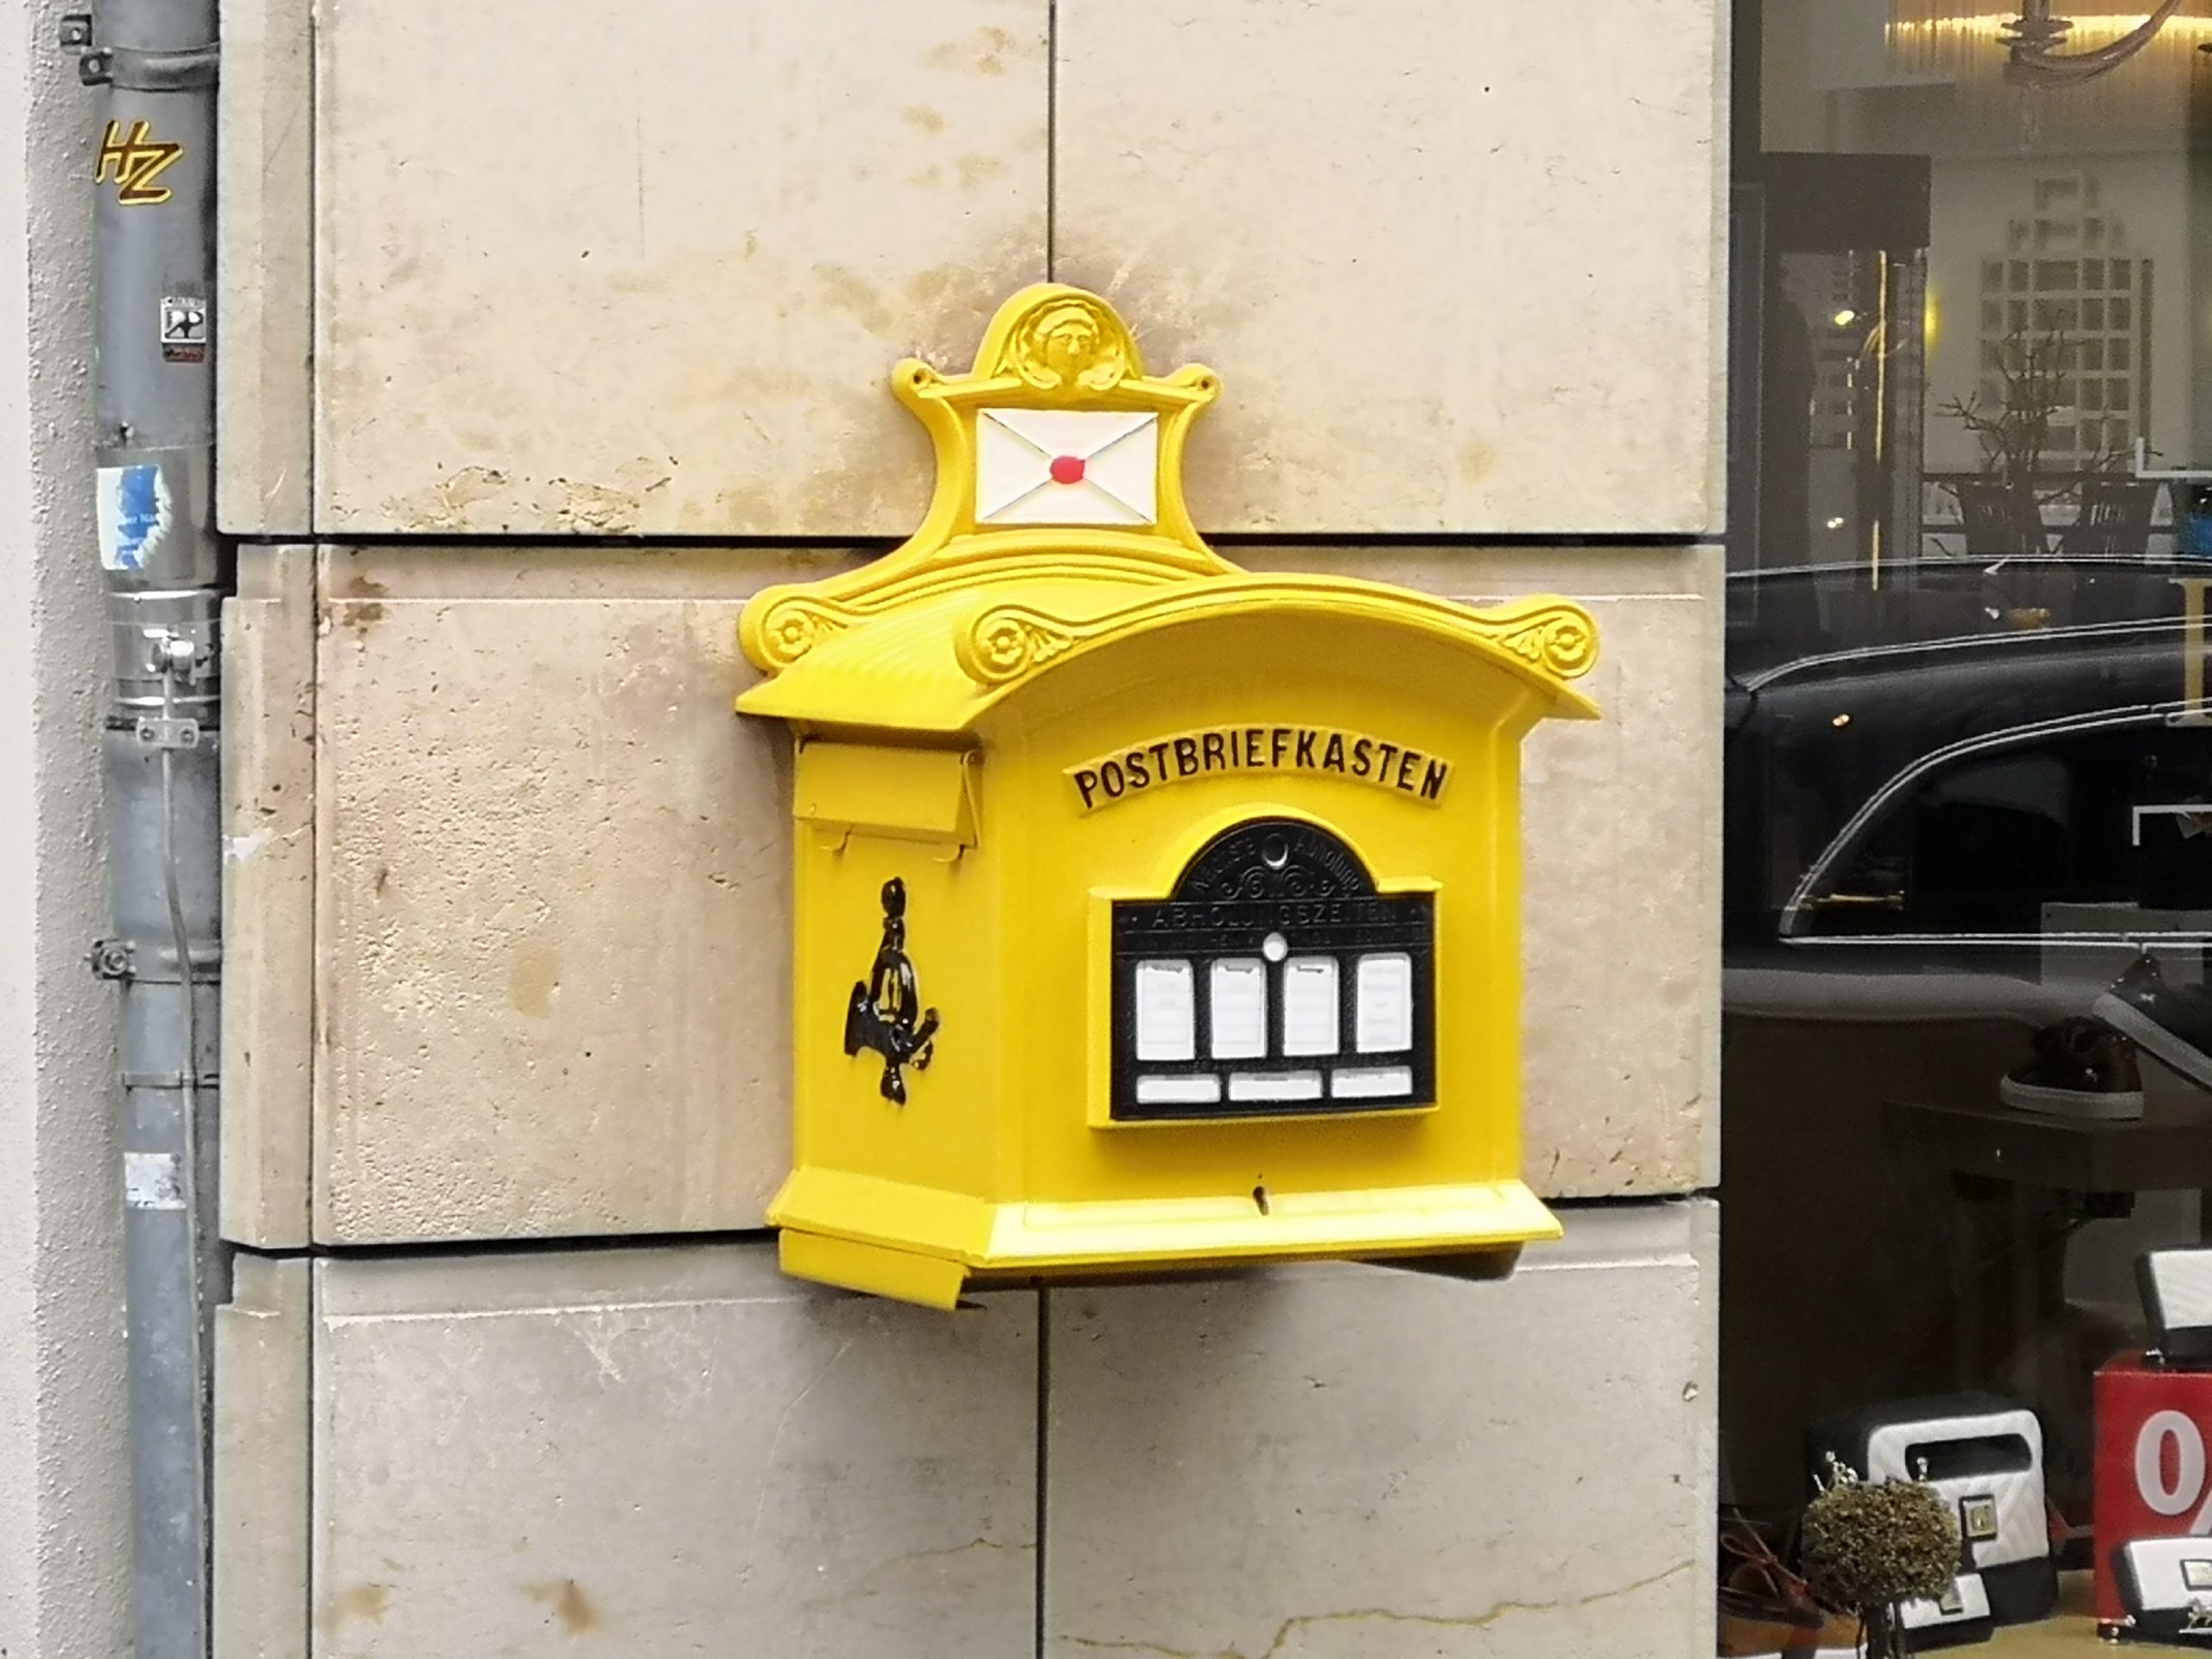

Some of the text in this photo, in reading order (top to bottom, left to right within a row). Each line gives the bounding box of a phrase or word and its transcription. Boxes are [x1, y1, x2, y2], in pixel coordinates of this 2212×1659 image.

[95, 119, 184, 206] HZ
[1074, 728, 1448, 810] POSTBRIEFKASTEN
[2134, 1409, 2212, 1535] 0
